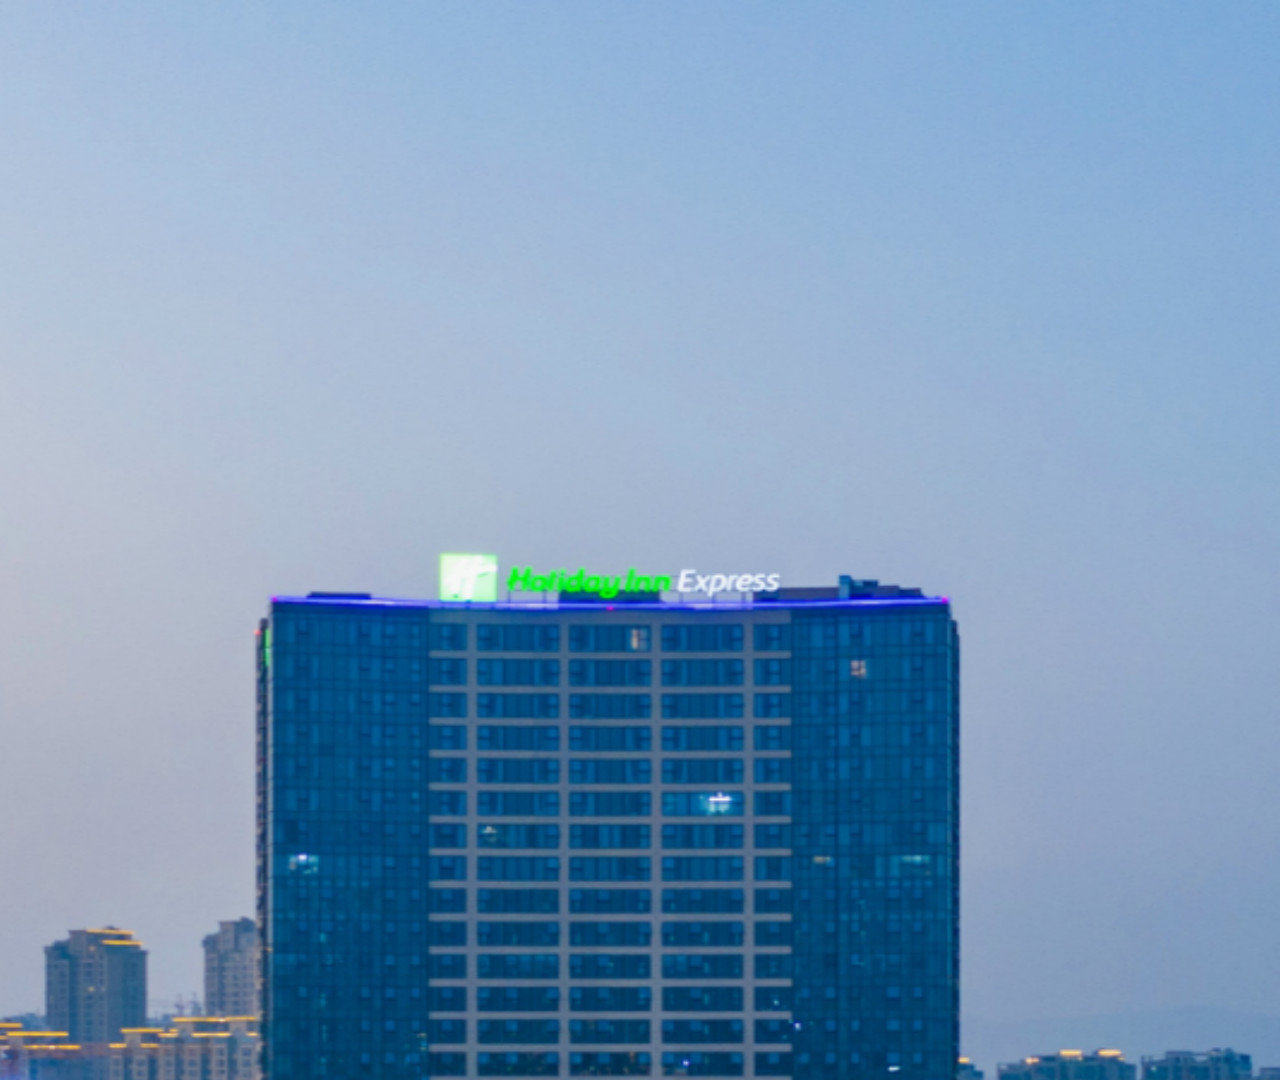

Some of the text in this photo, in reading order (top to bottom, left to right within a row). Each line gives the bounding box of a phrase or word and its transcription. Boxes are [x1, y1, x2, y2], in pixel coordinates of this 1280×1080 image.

[507, 567, 780, 598] Holiday Inn Express
